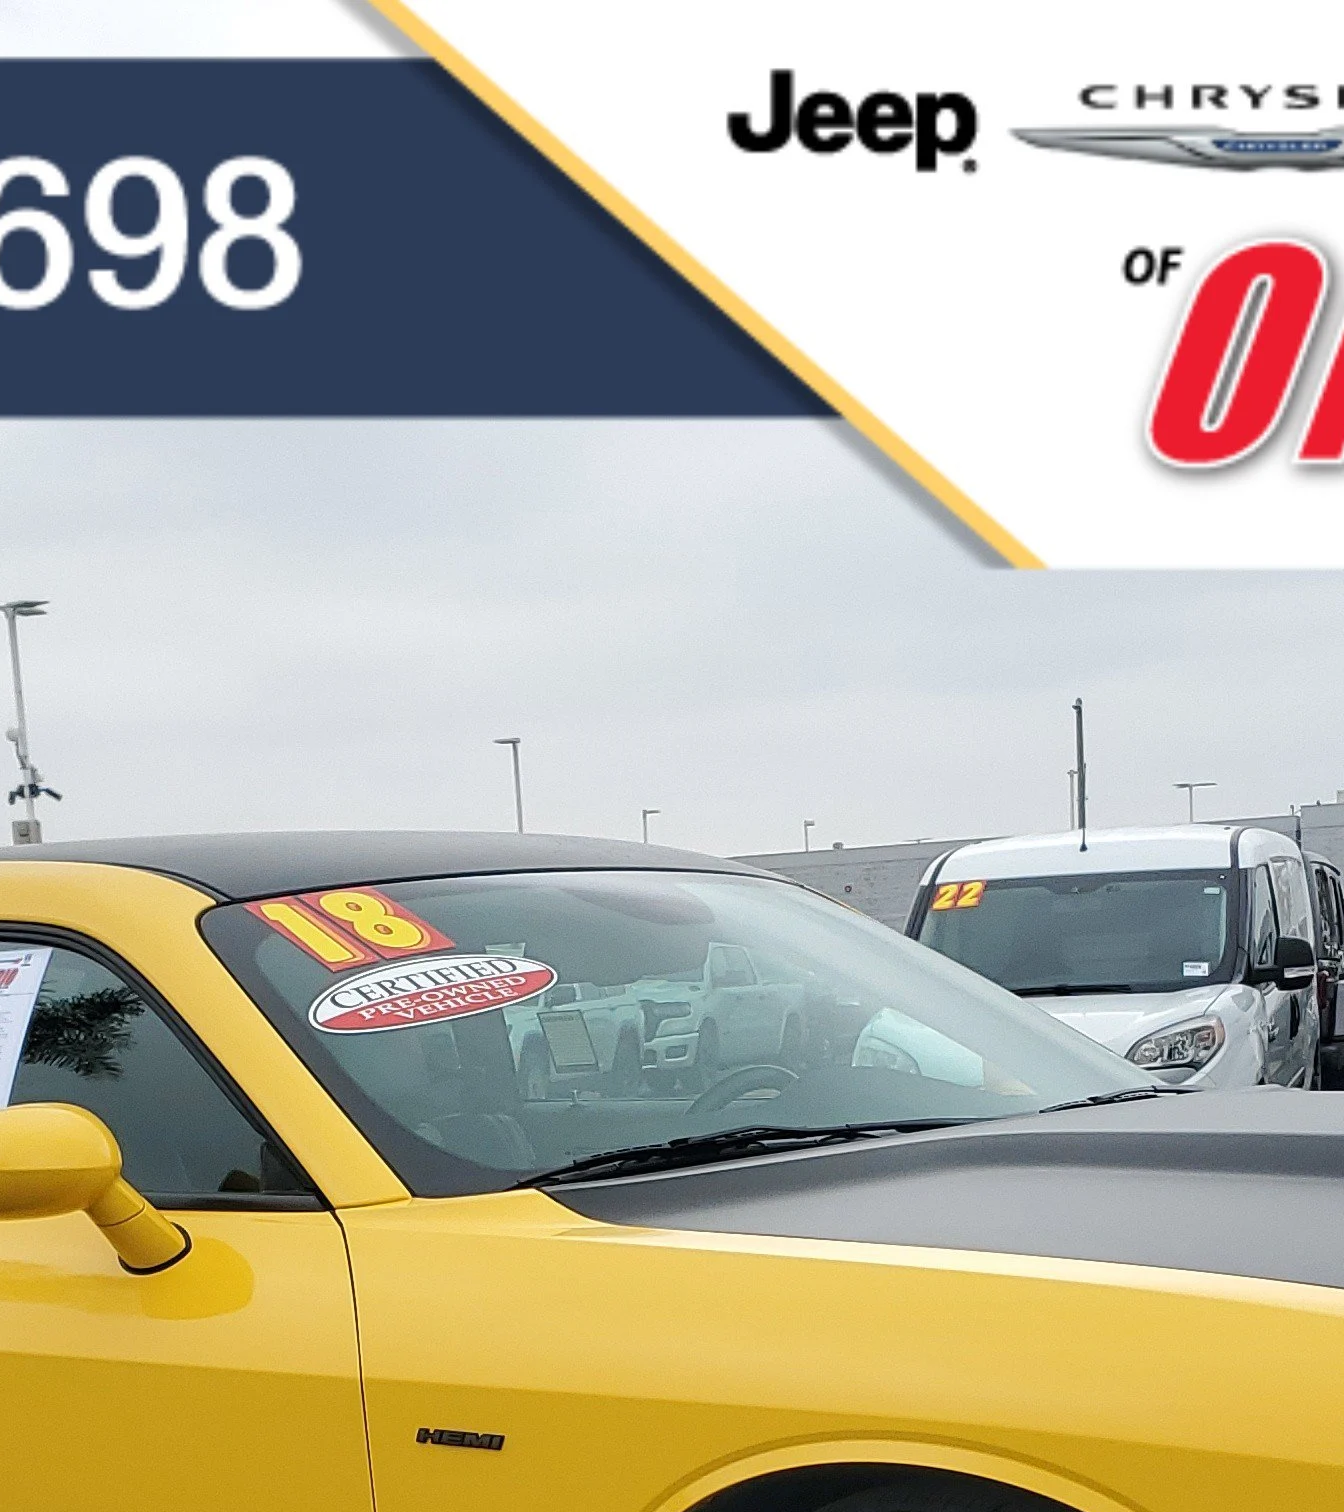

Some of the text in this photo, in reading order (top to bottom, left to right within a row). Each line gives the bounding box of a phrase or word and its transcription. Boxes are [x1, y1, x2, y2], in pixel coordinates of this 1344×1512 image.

[932, 881, 983, 909] 22
[260, 891, 427, 963] 18
[330, 957, 518, 1009] CERTIFIED
[357, 974, 527, 1021] PRE-OWNED
[393, 987, 519, 1020] VEHICLE
[416, 1428, 505, 1451] HEMI
